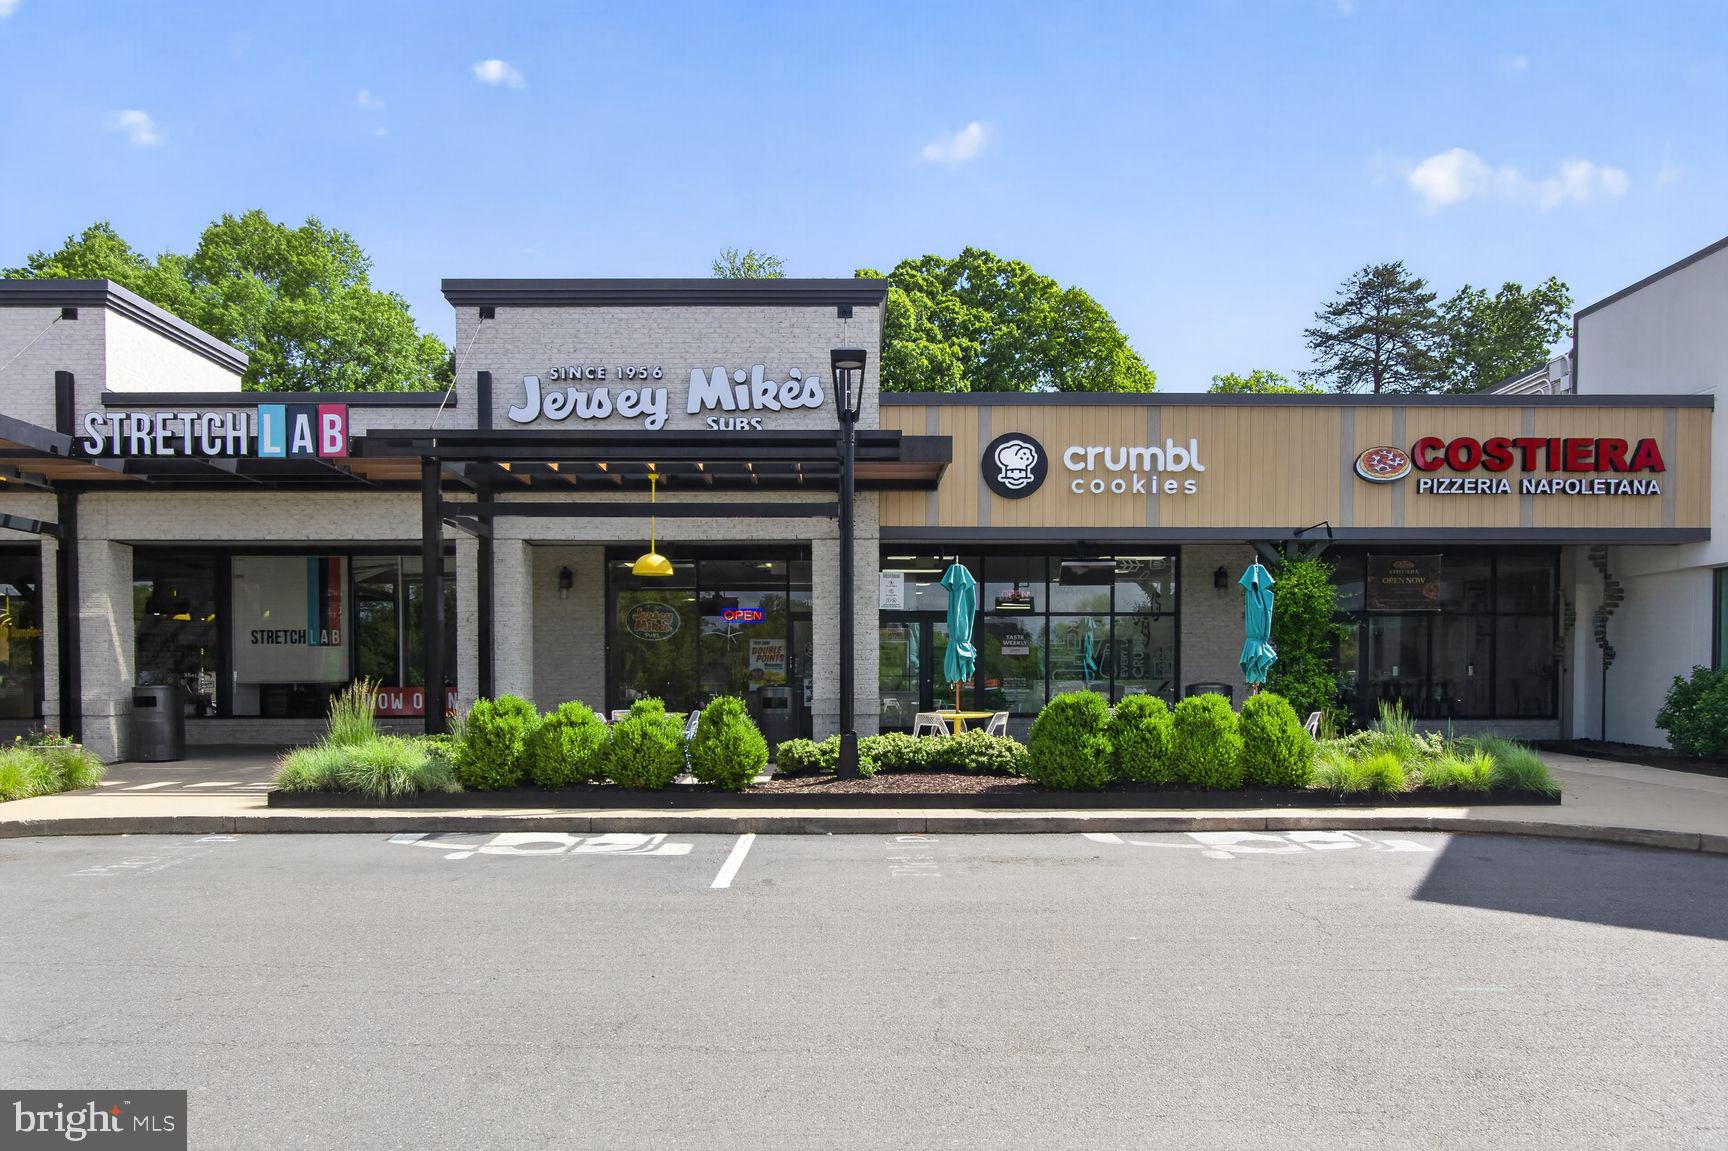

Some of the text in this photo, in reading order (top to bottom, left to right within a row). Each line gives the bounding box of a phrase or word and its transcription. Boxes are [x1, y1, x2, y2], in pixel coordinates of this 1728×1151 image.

[550, 366, 663, 380] SINCE 1956
[508, 364, 825, 430] Jersey Mike's
[706, 416, 762, 430] SUBS
[1063, 438, 1206, 472] crumbl
[1411, 437, 1666, 472] COSTIERA
[1071, 473, 1198, 494] cookies
[1417, 478, 1662, 495] PIZZERIA NAPOLETANA
[723, 610, 762, 620] OPEN
[752, 646, 782, 655] DOUBLE
[756, 654, 785, 663] POINTS
